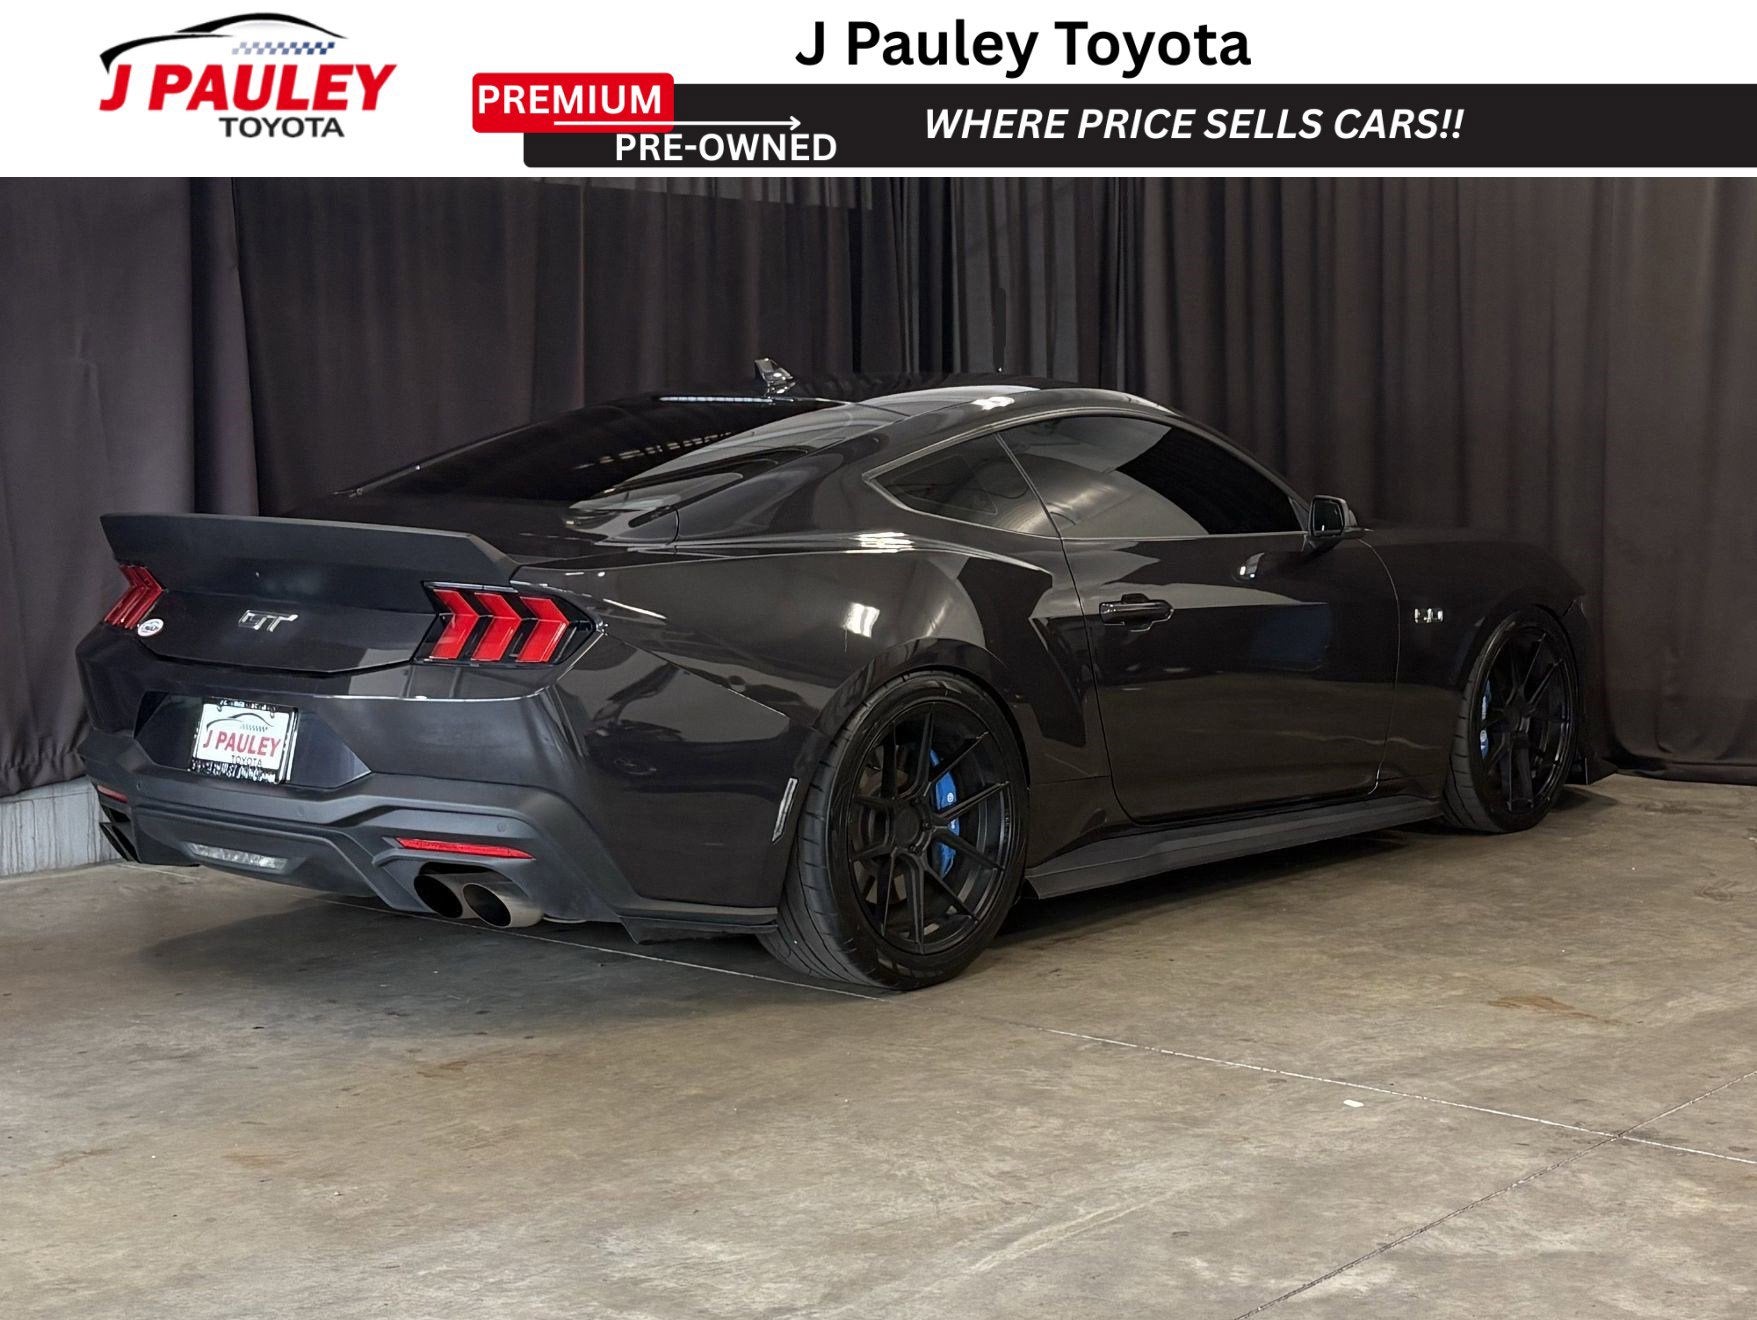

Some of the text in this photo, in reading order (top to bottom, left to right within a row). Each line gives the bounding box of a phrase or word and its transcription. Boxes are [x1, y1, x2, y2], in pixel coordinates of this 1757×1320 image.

[202, 730, 282, 757] J PAULEY
[231, 754, 263, 767] TOYOTA
